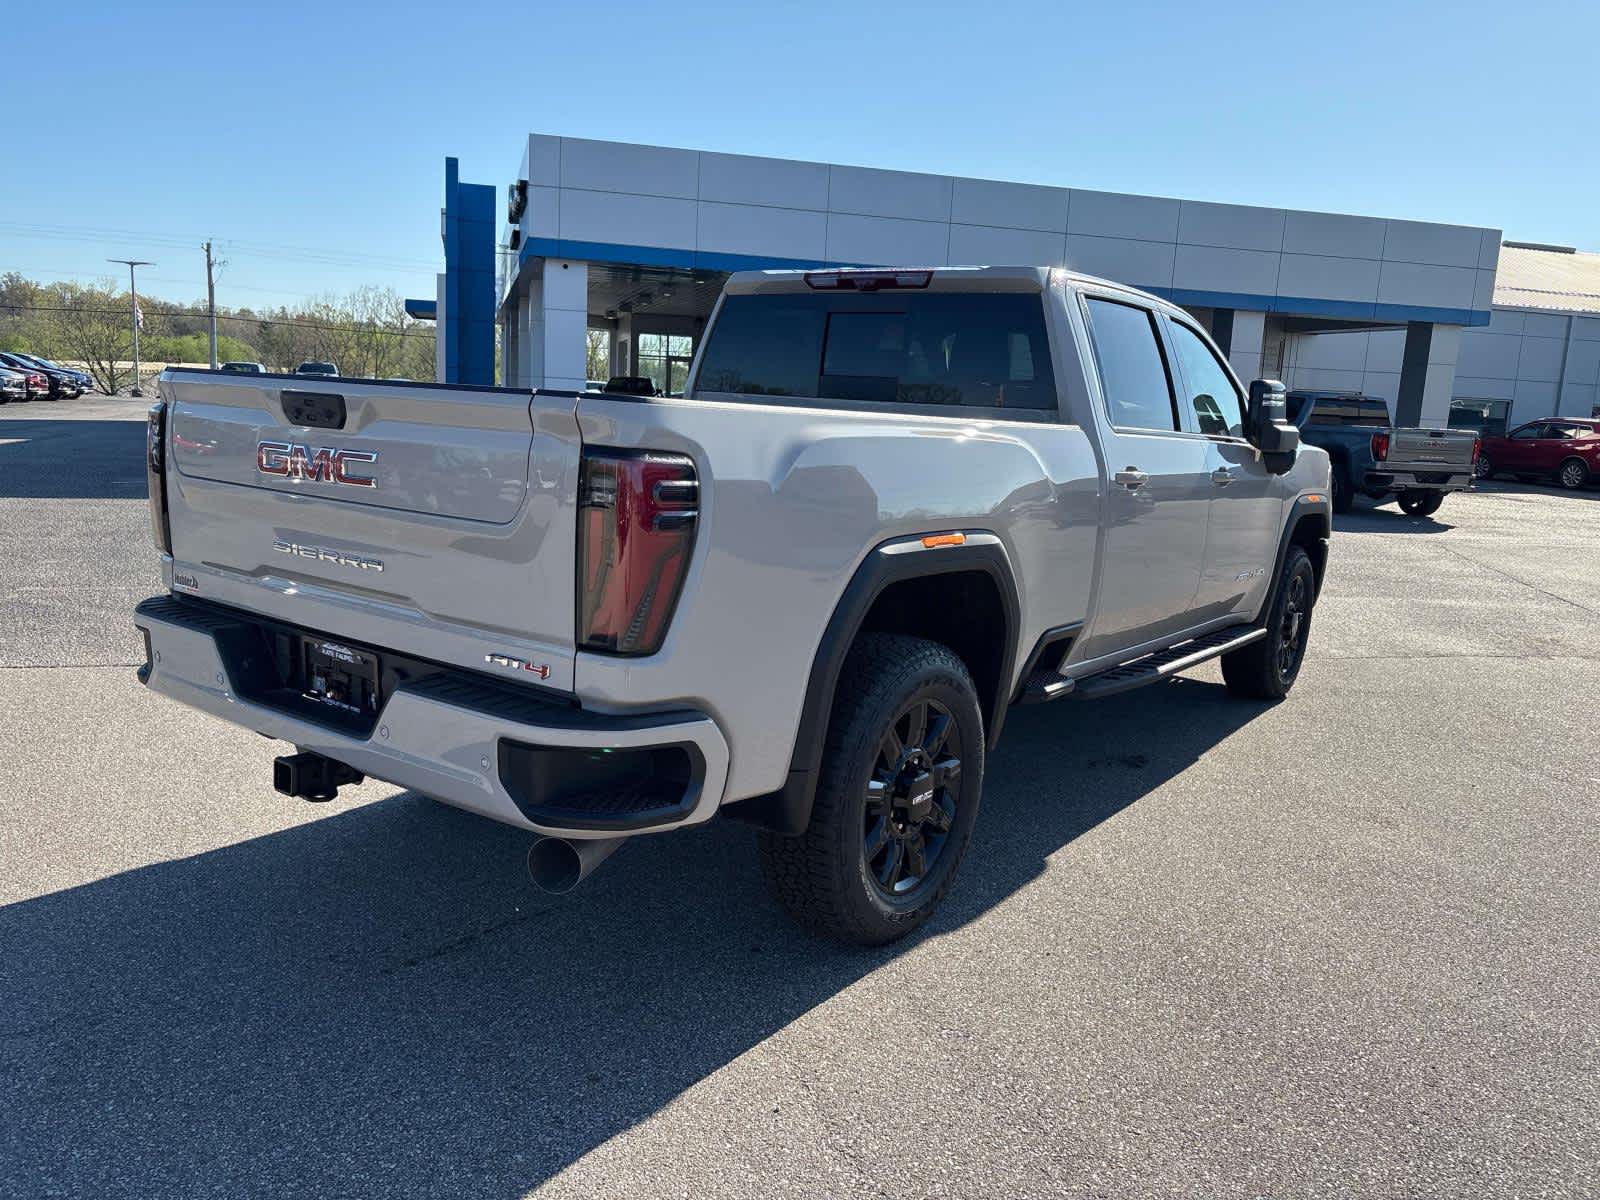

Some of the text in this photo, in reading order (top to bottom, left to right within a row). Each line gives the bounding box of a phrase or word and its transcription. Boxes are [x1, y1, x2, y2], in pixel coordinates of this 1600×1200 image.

[257, 440, 378, 489] GMC
[272, 539, 385, 572] SIERRA
[484, 653, 551, 680] AT4
